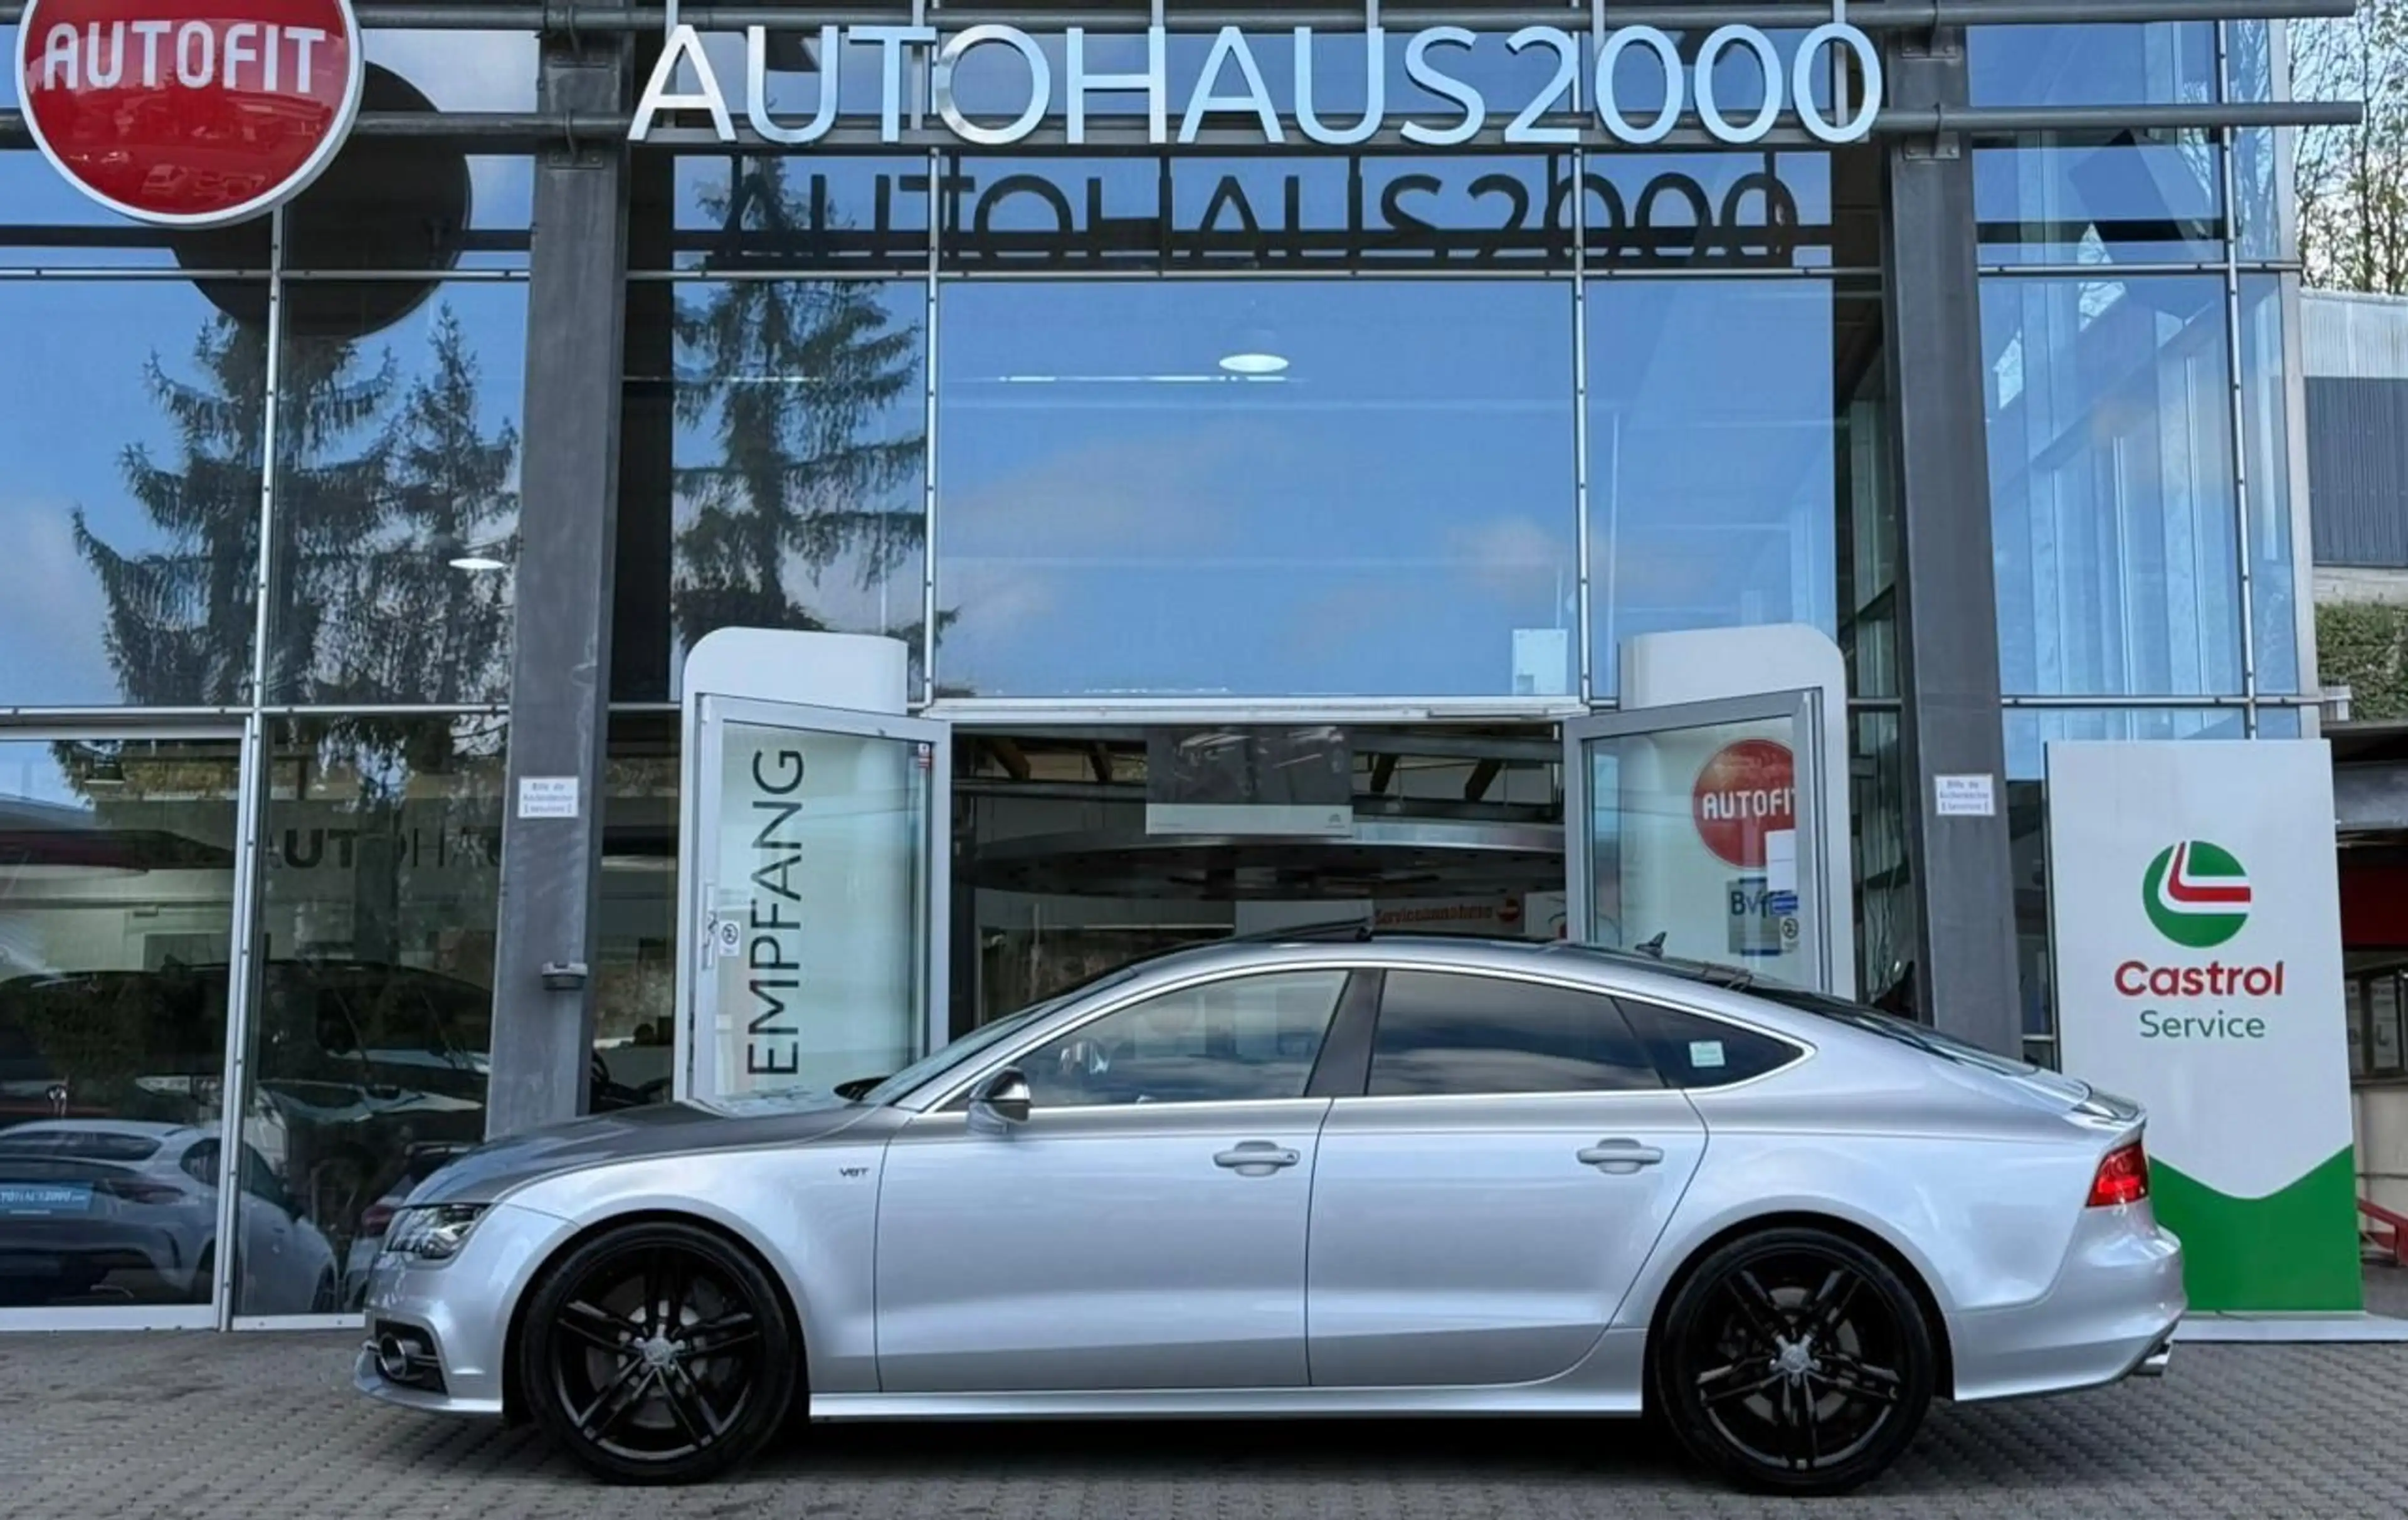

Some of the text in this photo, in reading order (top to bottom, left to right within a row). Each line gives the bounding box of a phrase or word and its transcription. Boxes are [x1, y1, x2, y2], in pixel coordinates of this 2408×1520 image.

[43, 19, 327, 94] AUTOFIT
[627, 23, 1883, 145] AUTOHAUS2000
[1701, 787, 1796, 820] AUTOFI
[747, 748, 804, 1075] EMPFANG
[2114, 961, 2284, 997] Castrol
[2140, 1010, 2266, 1038] Service
